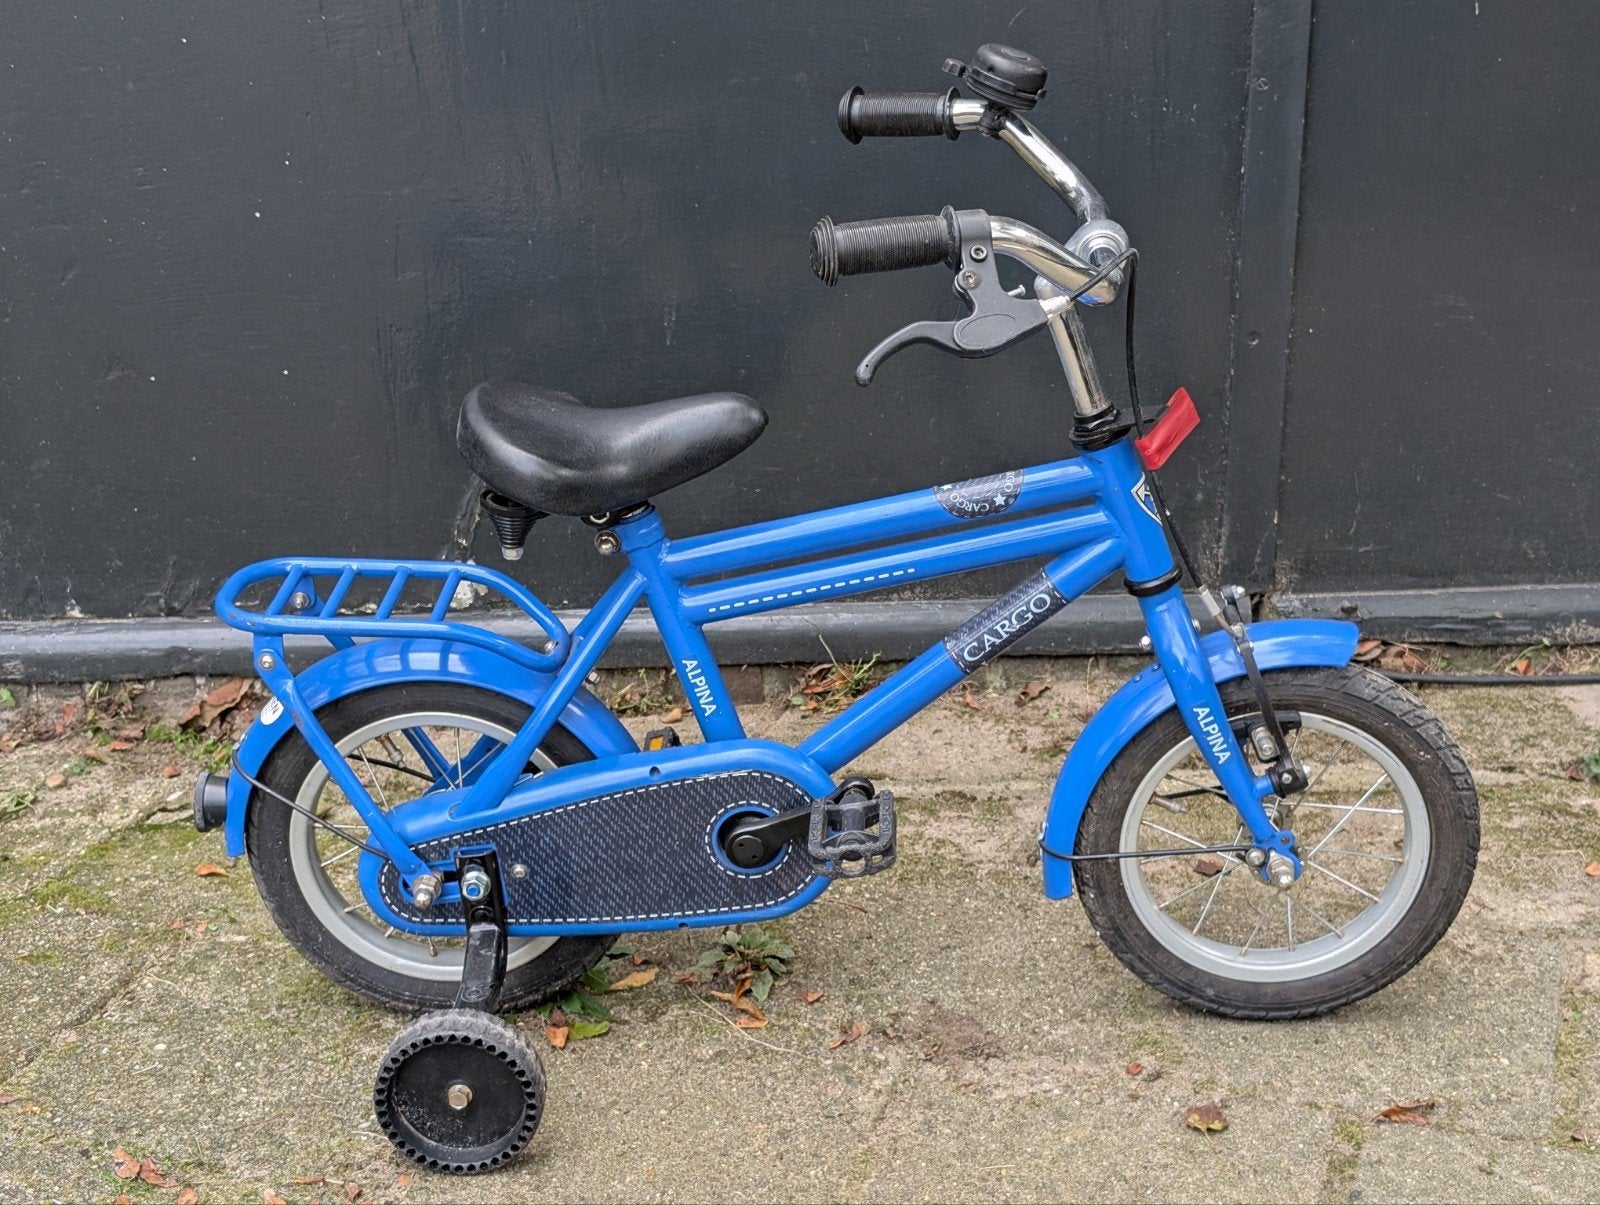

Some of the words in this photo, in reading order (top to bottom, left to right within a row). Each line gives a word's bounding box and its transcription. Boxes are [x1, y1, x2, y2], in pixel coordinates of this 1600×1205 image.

[949, 492, 990, 512] CARGO
[963, 593, 1051, 662] CARGO
[681, 659, 717, 717] ALPINA
[1192, 706, 1231, 765] ALPINA
